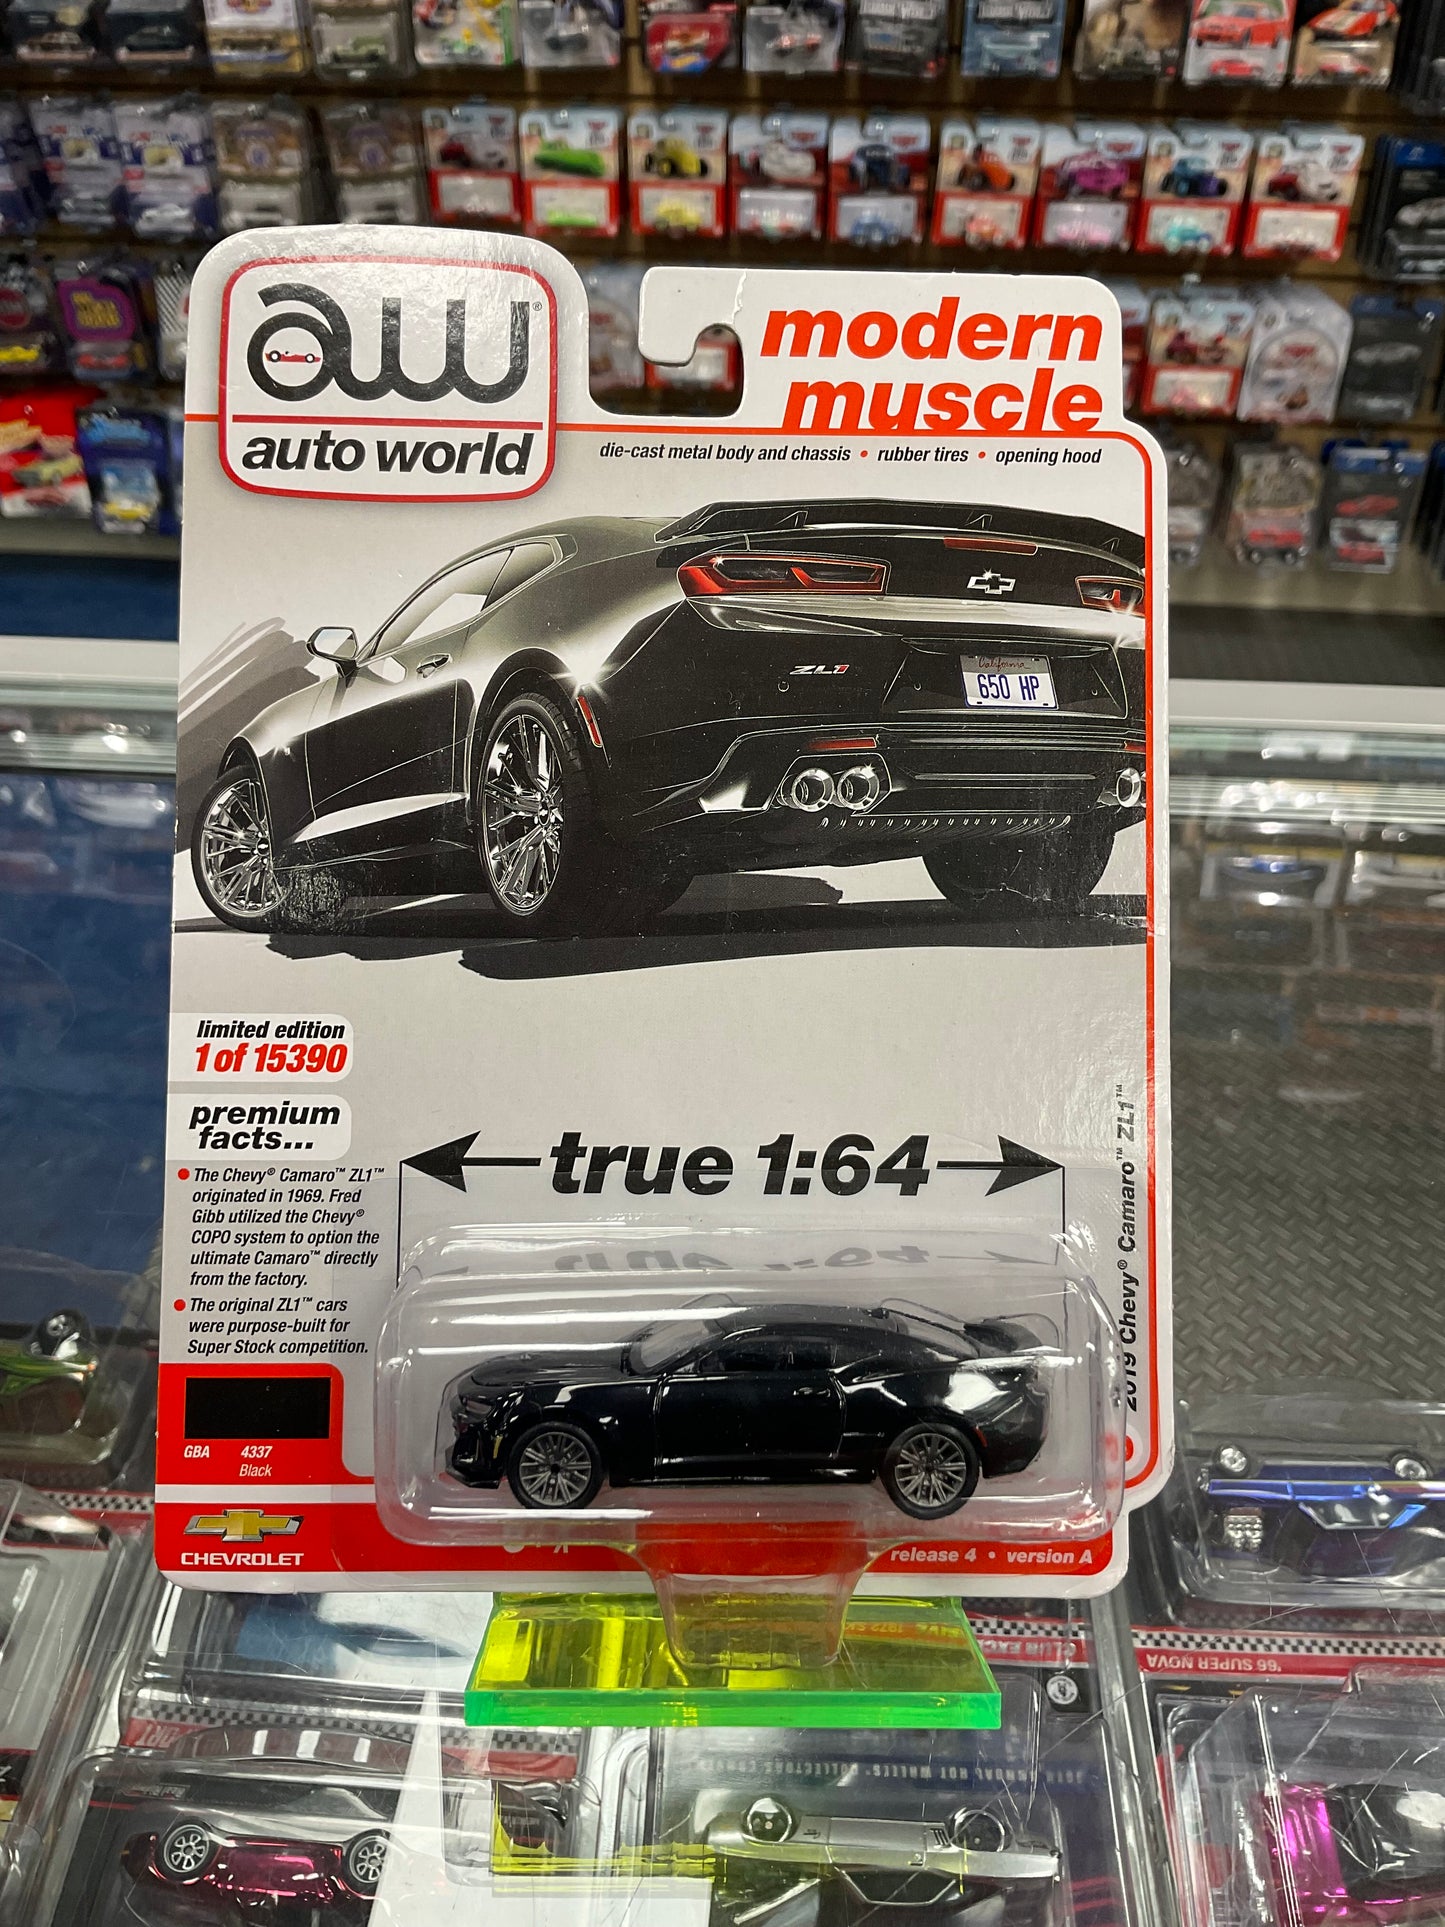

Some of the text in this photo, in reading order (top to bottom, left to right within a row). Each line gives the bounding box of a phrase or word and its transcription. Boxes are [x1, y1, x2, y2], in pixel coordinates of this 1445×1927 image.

[760, 297, 1103, 361] modern
[782, 368, 1103, 432] muscle
[242, 430, 534, 475] auto world
[600, 443, 1102, 466] die-cast metal body and chassis rubber tires opening hood
[789, 664, 849, 675] ZL1
[977, 674, 1040, 701] 650 HP
[197, 1020, 345, 1038] limited edition
[196, 1043, 348, 1073] 1 of 15390
[189, 1101, 340, 1129] premium
[199, 1126, 313, 1149] facts...
[550, 1132, 930, 1196] true 1:64
[195, 1168, 219, 1181] The
[193, 1189, 361, 1205] originated in 1969. Fred
[193, 1209, 224, 1223] Gibb
[229, 1209, 282, 1223] utilized
[286, 1209, 308, 1223] the
[192, 1230, 379, 1247] COPO system to option the
[191, 1251, 250, 1264] ultimate
[324, 1251, 378, 1267] directly
[190, 1272, 307, 1288] from the factory.
[191, 1298, 215, 1311] The
[219, 1298, 274, 1314] original
[316, 1301, 347, 1311] cars
[190, 1318, 350, 1335] were purpose-built for
[188, 1339, 368, 1356] Super Stock competition.
[184, 1445, 272, 1458] GBA 4337
[240, 1464, 271, 1476] Black
[181, 1553, 304, 1565] CHEVROLET
[892, 1548, 1092, 1563] release 4 version A
[1146, 1654, 1281, 1672] '66 SUPER NOVA
[941, 1767, 968, 1781] HOT
